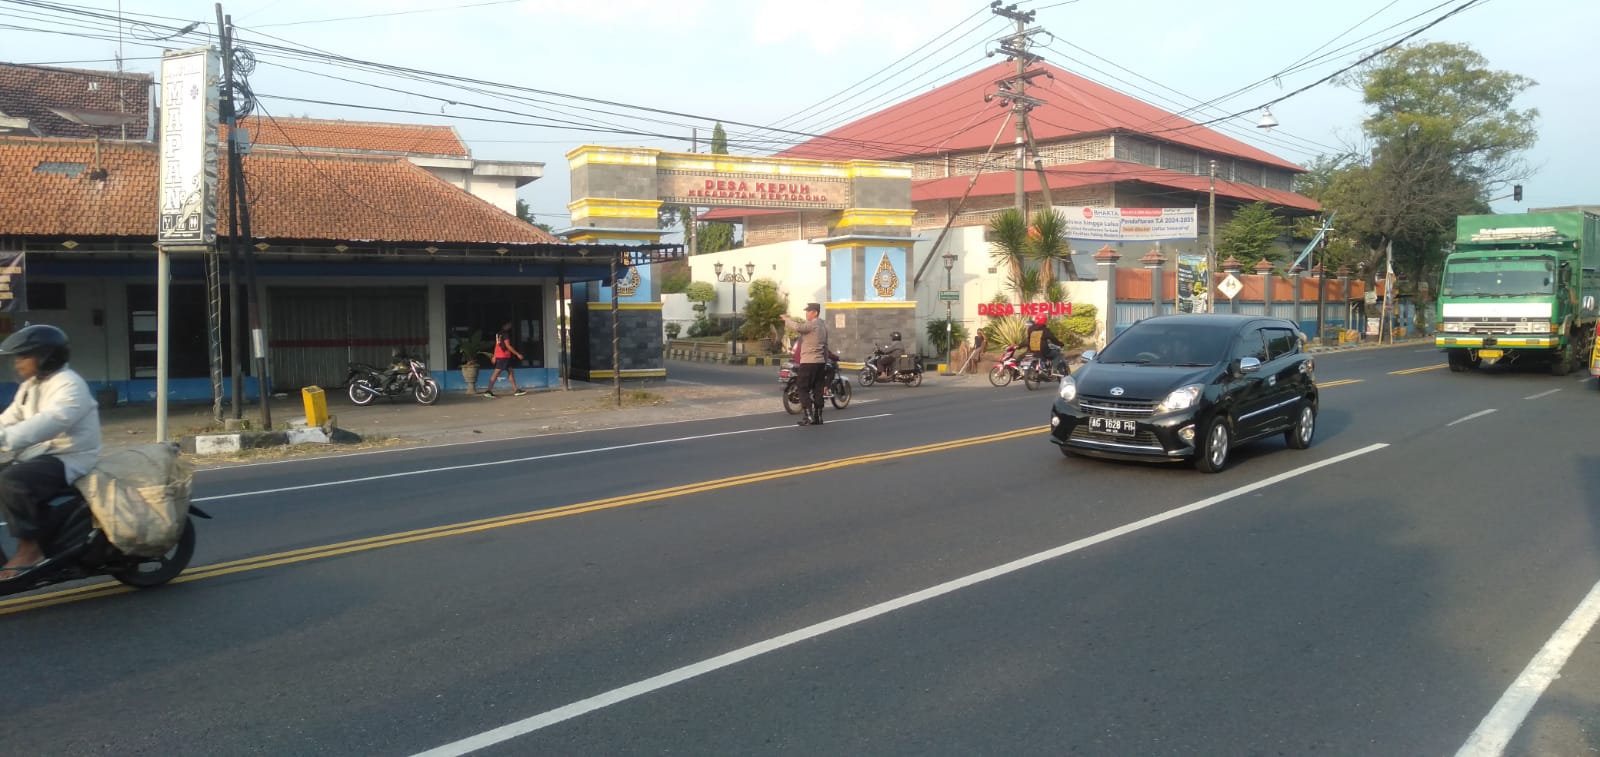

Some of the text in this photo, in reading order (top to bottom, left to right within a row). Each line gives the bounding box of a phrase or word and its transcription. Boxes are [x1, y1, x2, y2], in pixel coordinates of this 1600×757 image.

[165, 81, 184, 210] MAPAN
[705, 179, 810, 194] DESA KEPUH
[688, 189, 755, 199] KECAMATAN
[977, 302, 1072, 316] DESA KEPUH
[1091, 418, 1101, 428] AG
